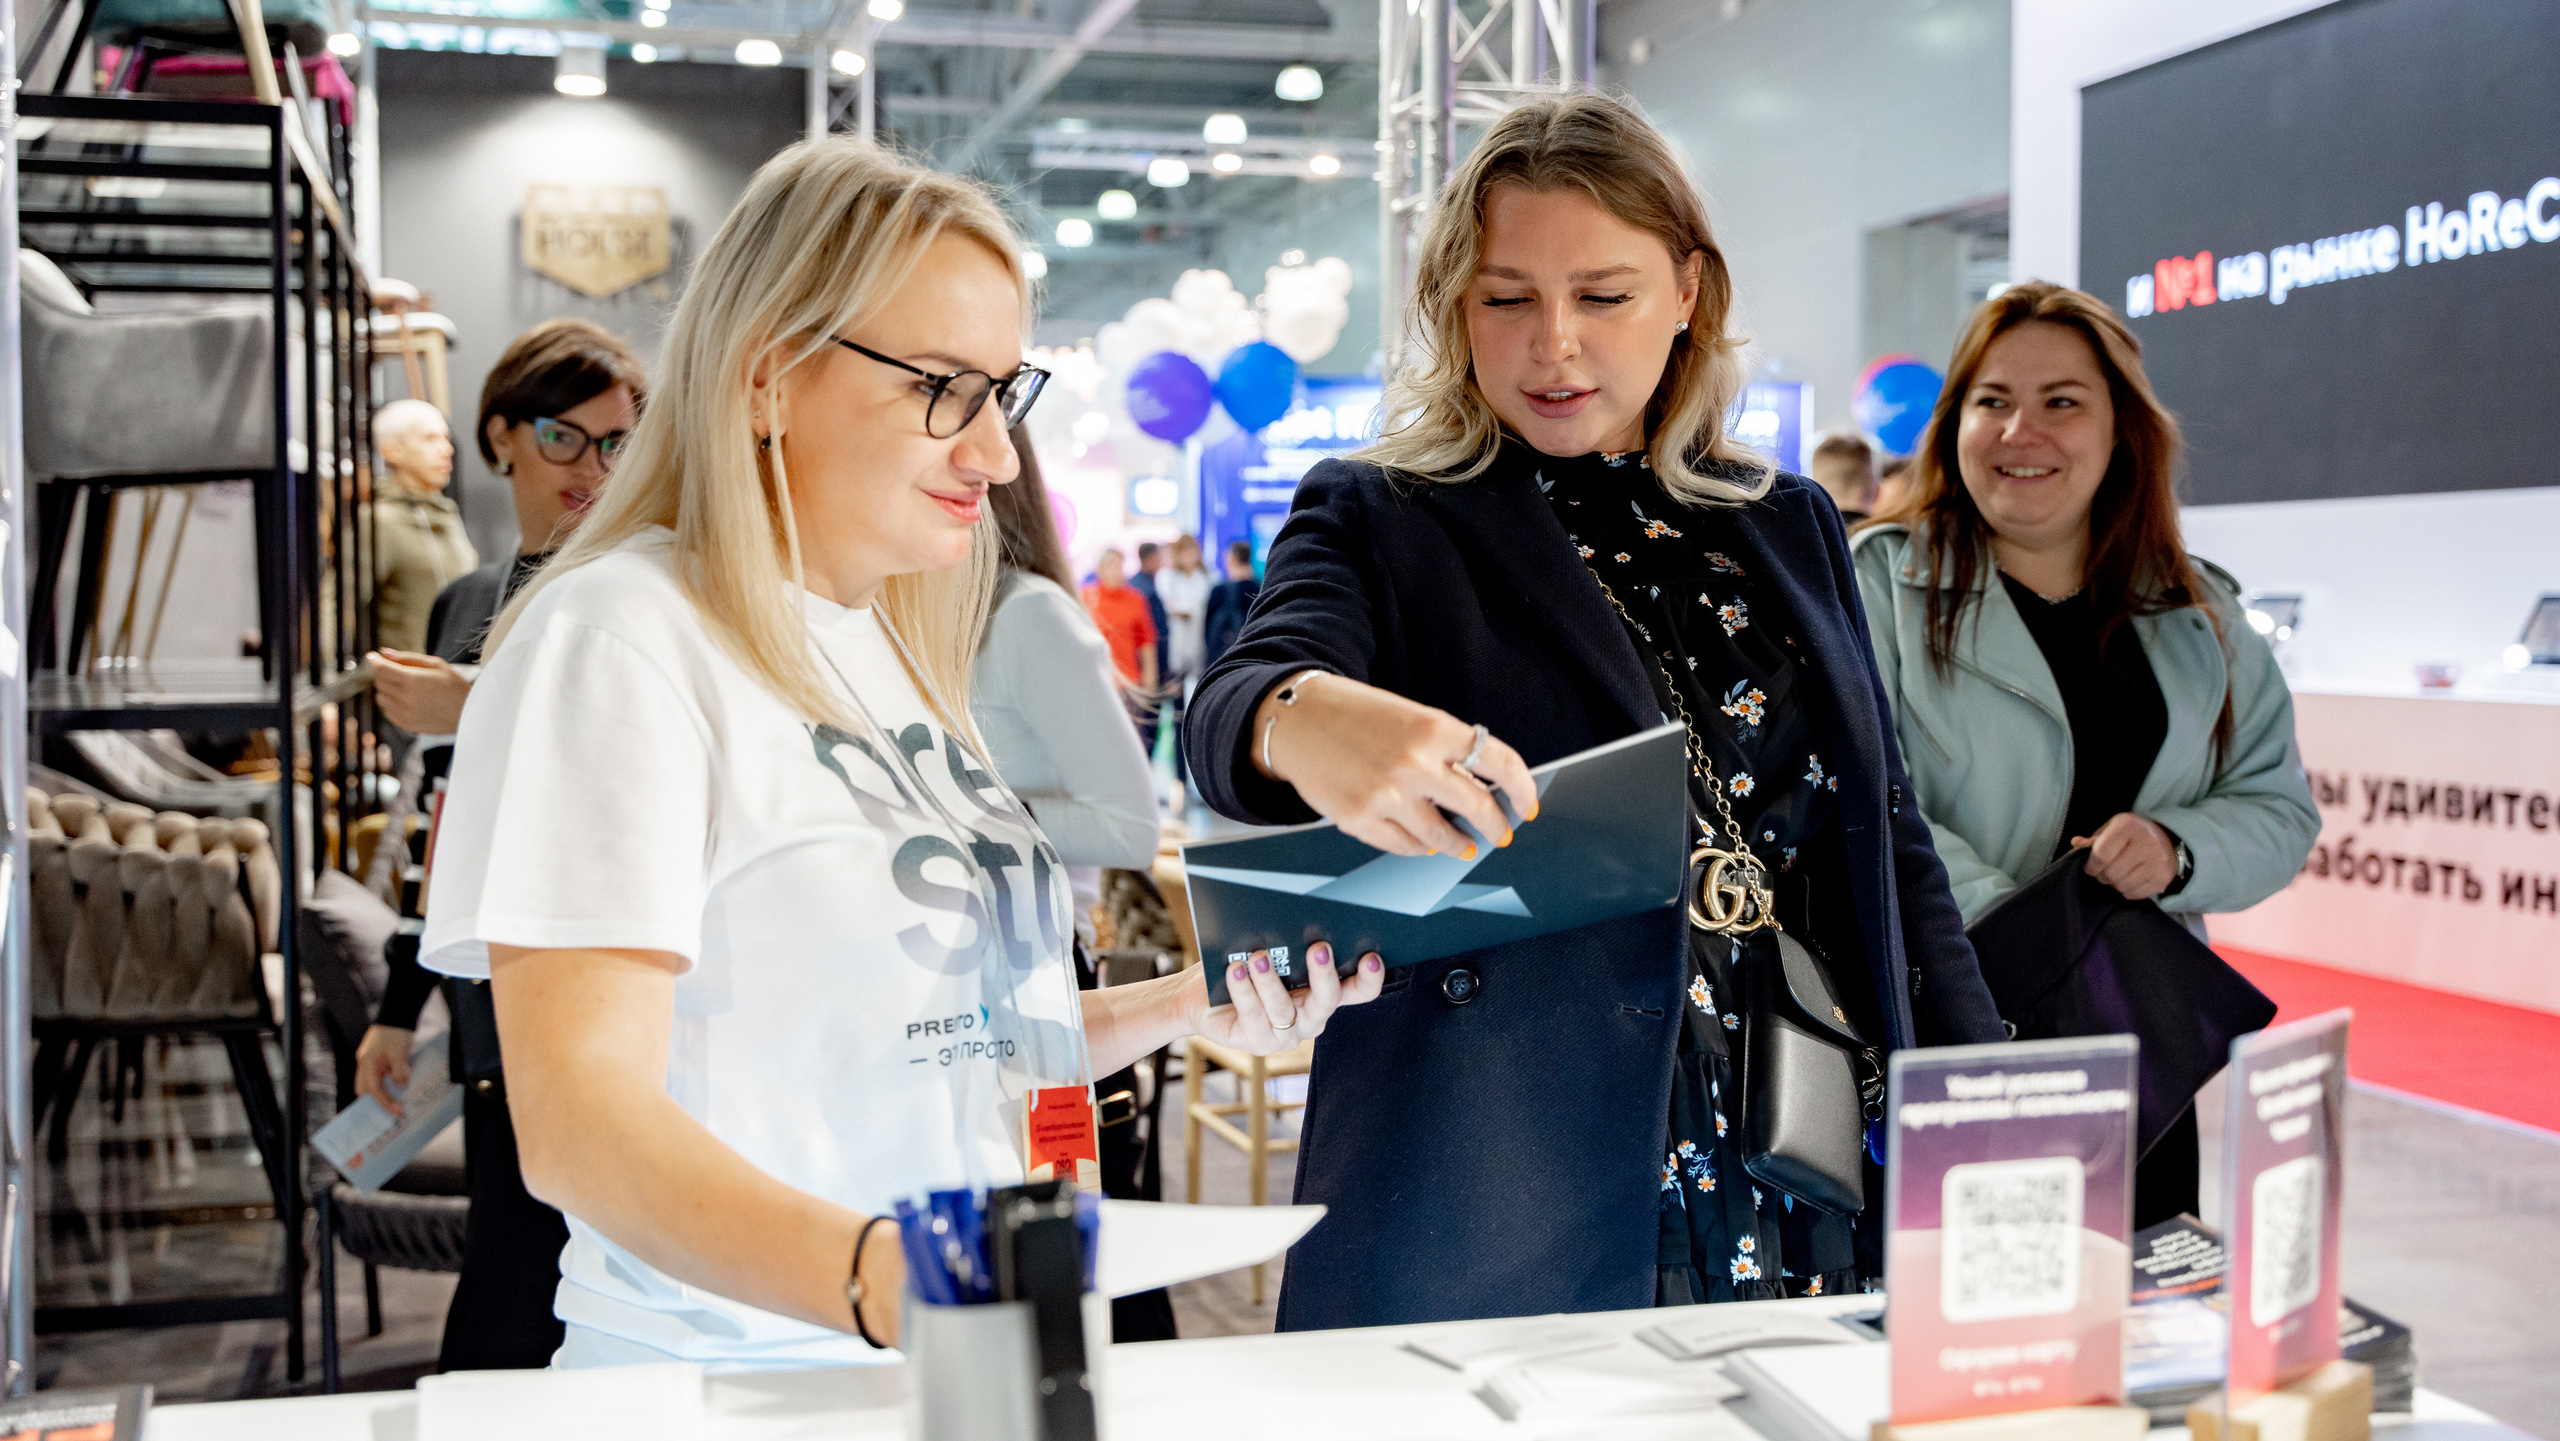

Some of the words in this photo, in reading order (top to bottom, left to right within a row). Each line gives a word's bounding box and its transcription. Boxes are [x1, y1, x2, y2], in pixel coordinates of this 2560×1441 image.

[2127, 274, 2154, 318] и
[2155, 250, 2218, 313] №1
[2218, 251, 2268, 302] на
[2269, 225, 2400, 305] рынке
[2405, 177, 2560, 266] HoReC
[2305, 769, 2347, 806] ы
[2360, 771, 2560, 832] удивите
[2301, 834, 2483, 903] аботать
